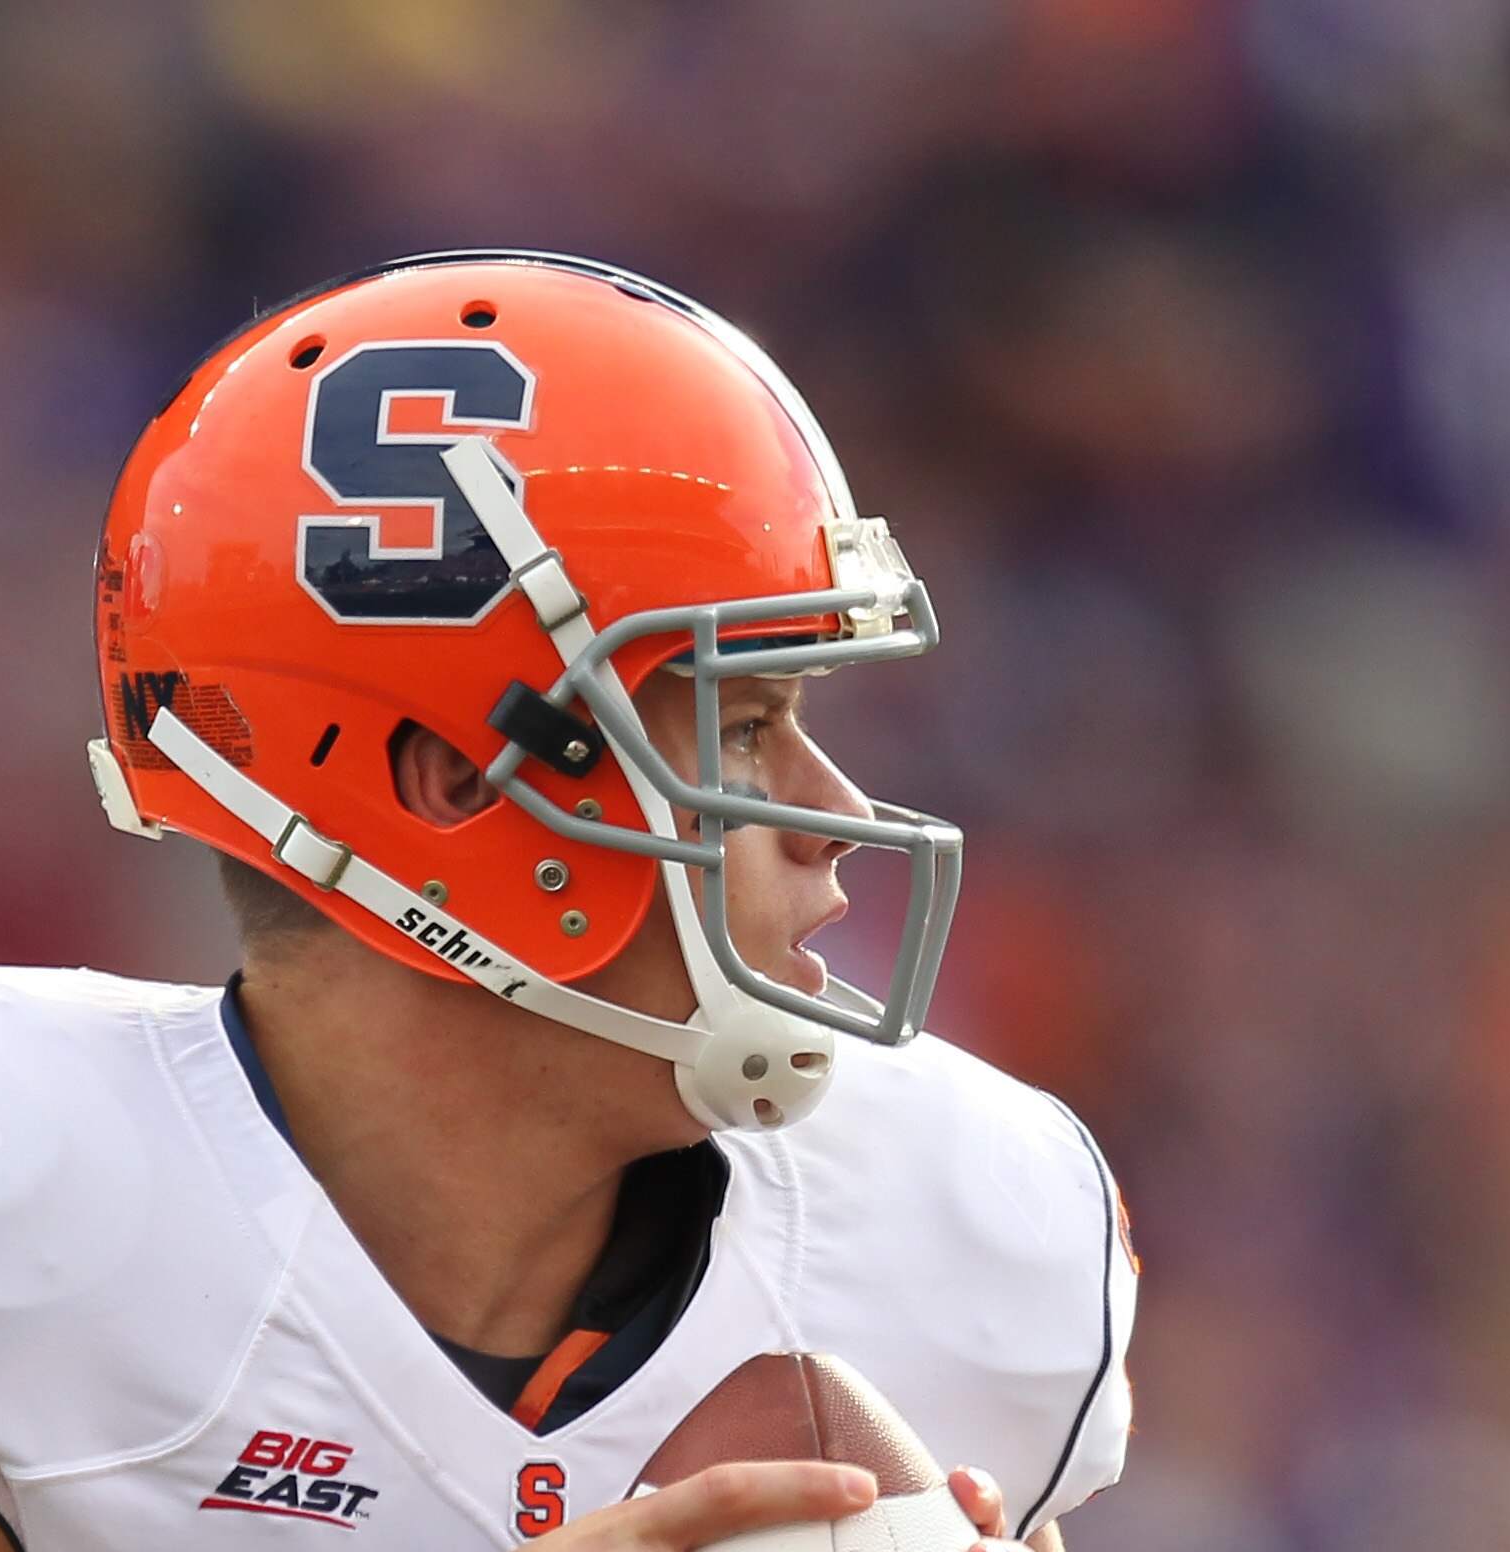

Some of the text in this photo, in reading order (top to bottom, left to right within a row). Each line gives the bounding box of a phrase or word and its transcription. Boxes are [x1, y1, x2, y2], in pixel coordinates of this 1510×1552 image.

[295, 338, 538, 627] S
[237, 1430, 353, 1477] BIG
[215, 1465, 379, 1518] EAST
[512, 1459, 567, 1540] S
